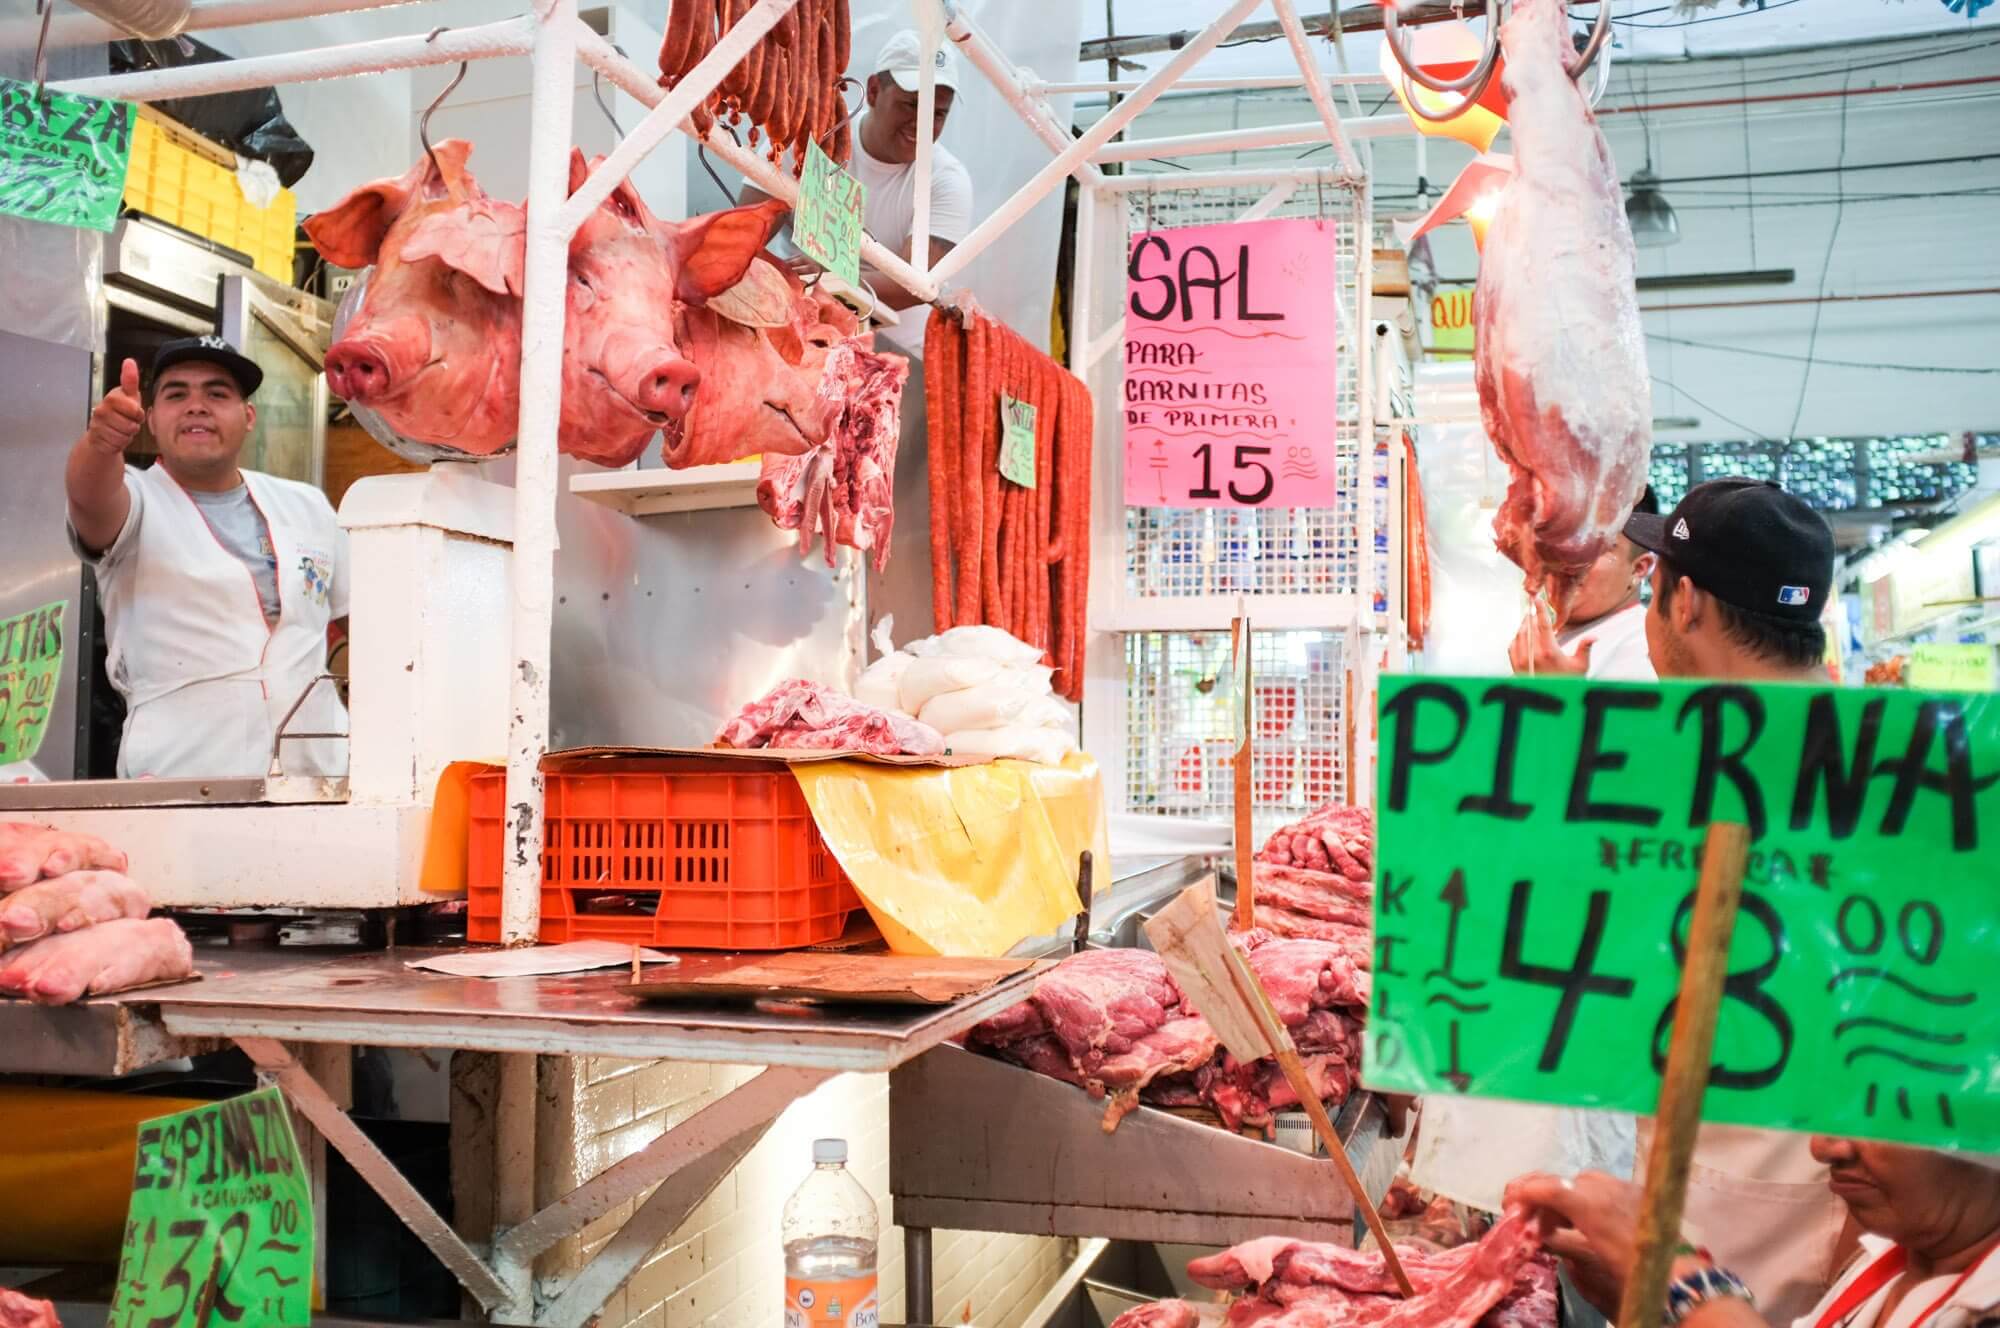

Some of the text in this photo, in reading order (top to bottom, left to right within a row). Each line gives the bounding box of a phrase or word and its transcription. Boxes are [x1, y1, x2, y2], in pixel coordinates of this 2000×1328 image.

[1127, 236, 1285, 322] SAL
[1125, 340, 1203, 367] PARA
[1126, 378, 1267, 405] CARNITAS
[1126, 409, 1278, 429] DE PRIMERA
[1188, 443, 1275, 505] 15
[0, 605, 63, 667] ITAS
[1381, 681, 2000, 852] PIERNA
[1627, 837, 1797, 886] FRCA
[1498, 879, 1944, 1091] 48 00
[147, 1199, 298, 1328] 32 00
